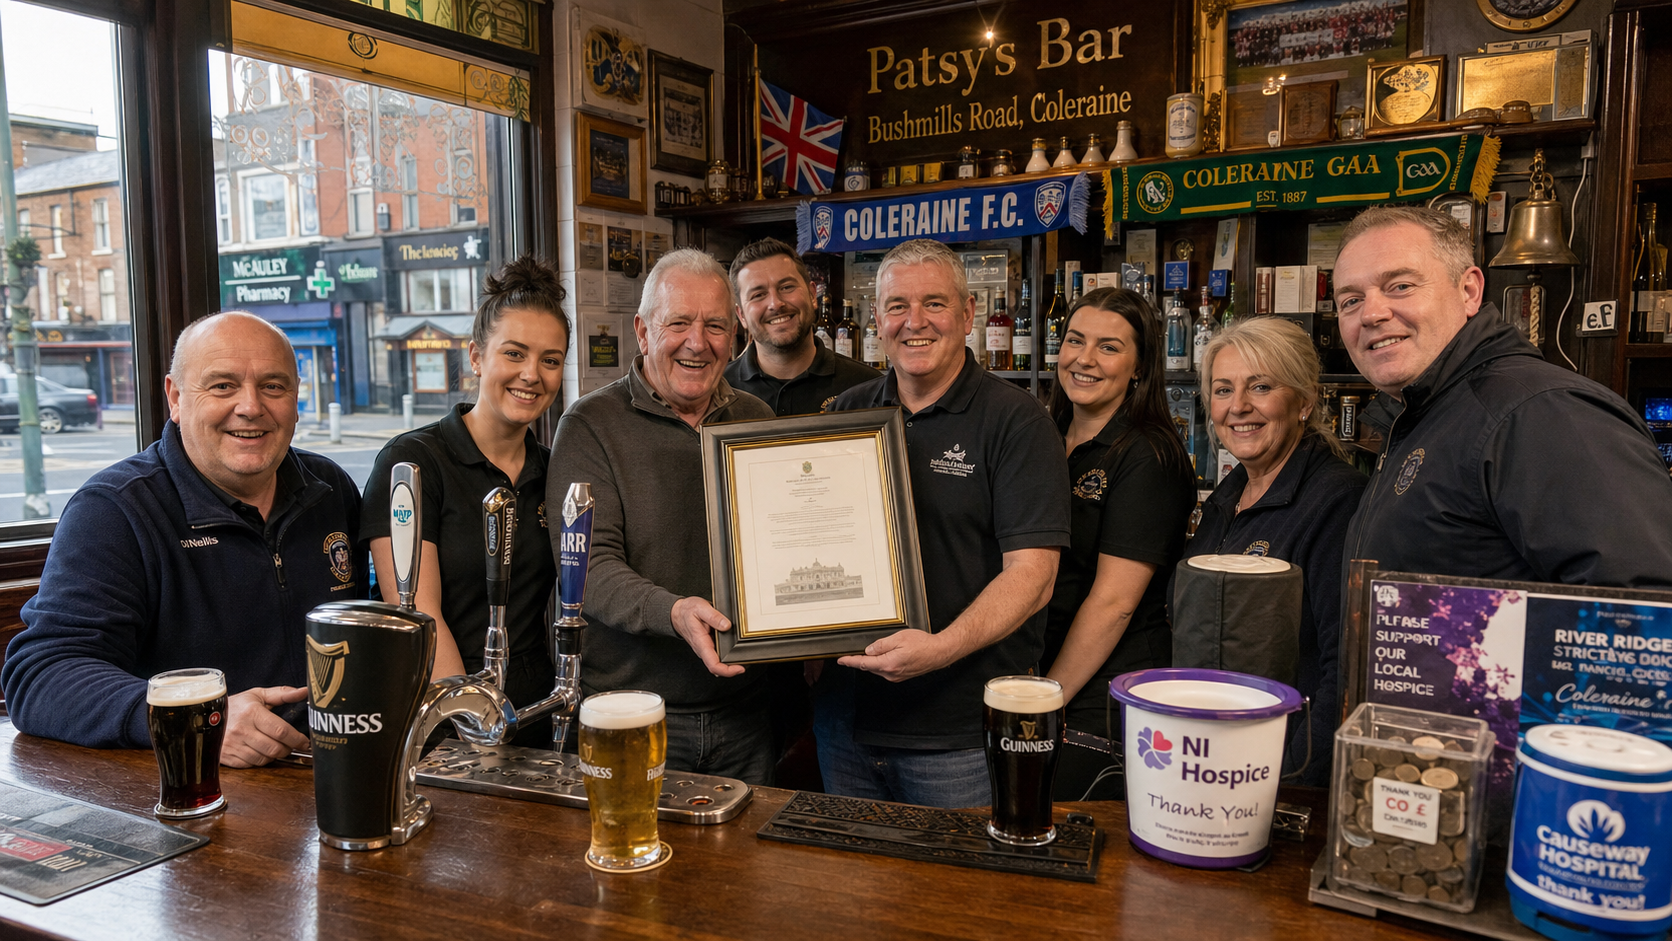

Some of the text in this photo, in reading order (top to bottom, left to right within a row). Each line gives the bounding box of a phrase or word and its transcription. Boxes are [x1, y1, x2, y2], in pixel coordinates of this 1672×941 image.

[867, 17, 1133, 97] Patsy's Bar
[867, 103, 963, 144] Bushmills
[968, 95, 1024, 132] Road,
[1030, 85, 1132, 124] Coleraine
[1182, 154, 1382, 190] COLERAINE GAA
[1256, 190, 1308, 204] EST. 1887
[844, 191, 1024, 242] COLERAINE F.C.
[236, 285, 291, 304] Pharmacy
[1375, 630, 1442, 647] SUPPORT
[1554, 629, 1609, 648] RIVER
[1374, 646, 1407, 660] OUR
[1374, 662, 1422, 679] LOCAL
[1373, 678, 1435, 696] HOSPICE
[1554, 682, 1655, 709] Coleraine
[1000, 736, 1055, 754] GUINNESS
[1181, 735, 1210, 759] NI
[1181, 761, 1270, 790] Hospice
[1147, 792, 1259, 823] Thank You!
[1413, 790, 1432, 802] YOU
[1538, 843, 1646, 881] HOSPITAL
[1536, 874, 1595, 904] thank
